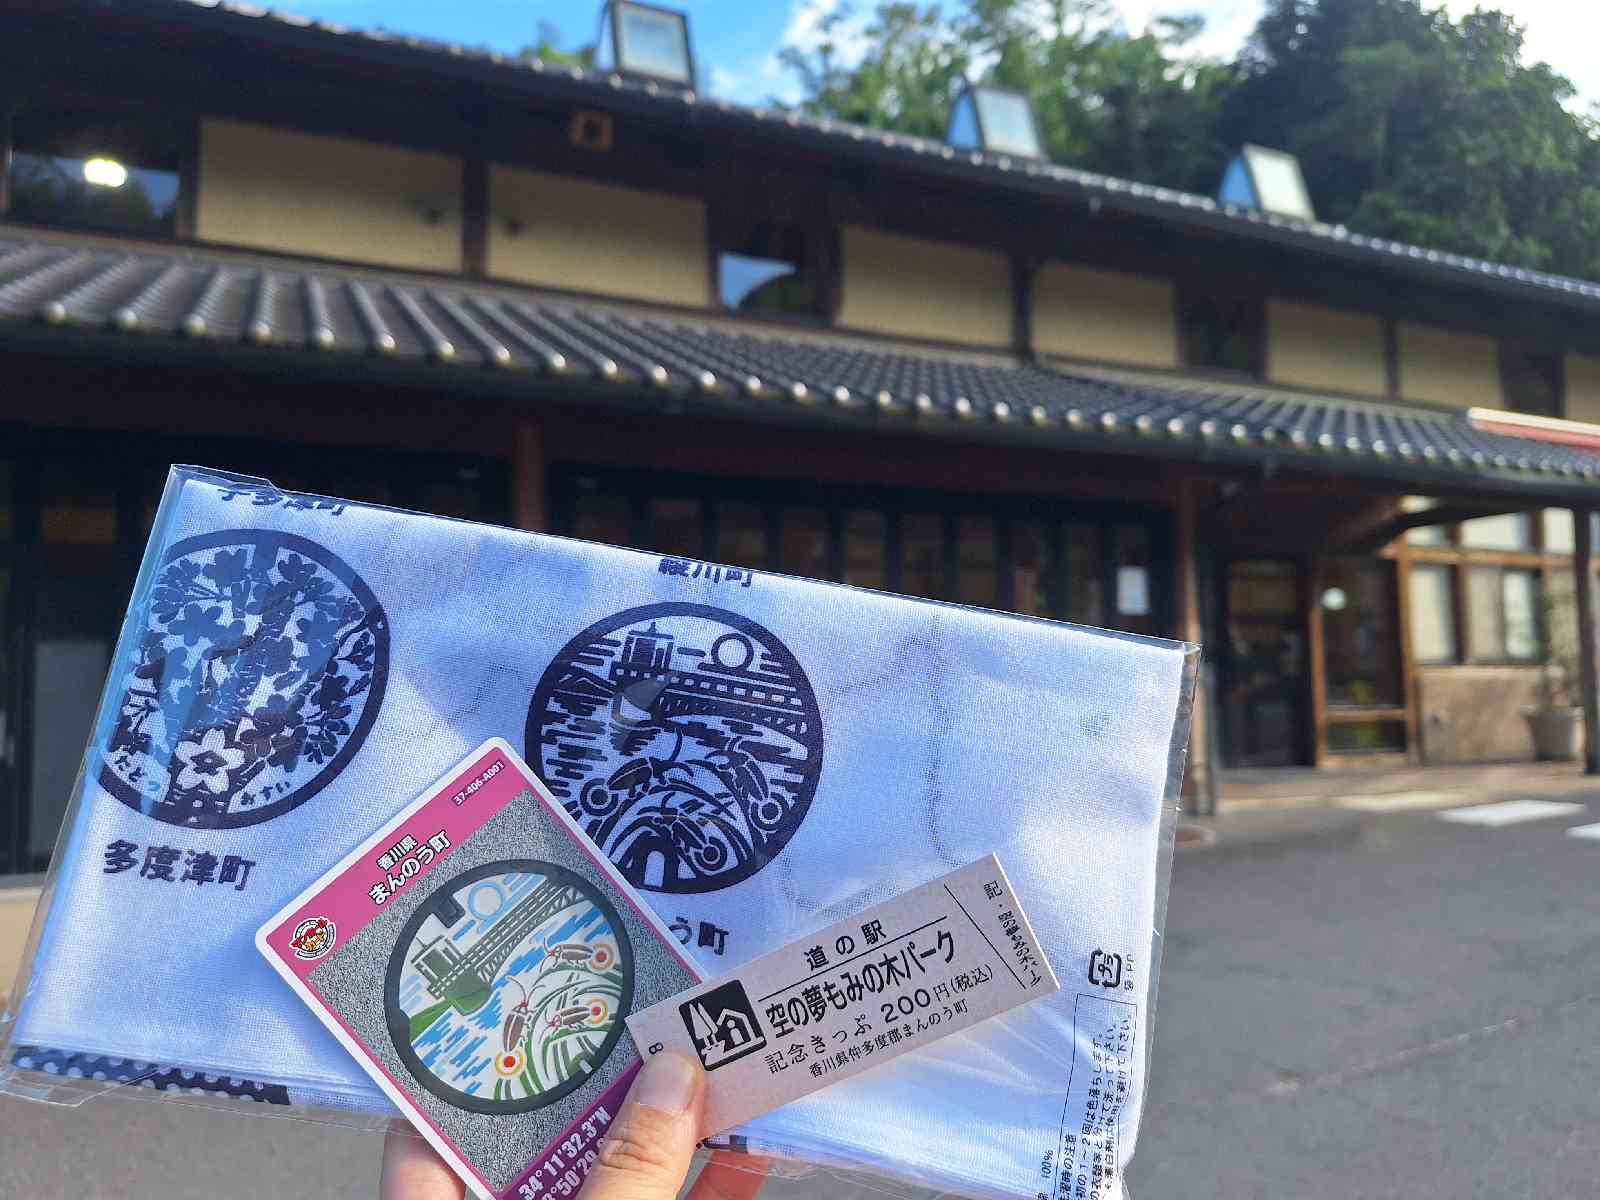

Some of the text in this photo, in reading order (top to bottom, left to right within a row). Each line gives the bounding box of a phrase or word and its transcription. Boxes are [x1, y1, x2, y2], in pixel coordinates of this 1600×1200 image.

[453, 760, 505, 806] 37-406-A001
[103, 839, 256, 890] 多度津町
[369, 830, 452, 905] まんのう町
[376, 834, 418, 872] 香川県
[804, 918, 888, 970] 道の駅
[765, 929, 955, 1040] 空の夢もみの木パーク
[809, 998, 969, 1080] 香川県仲多度郡まんのう町
